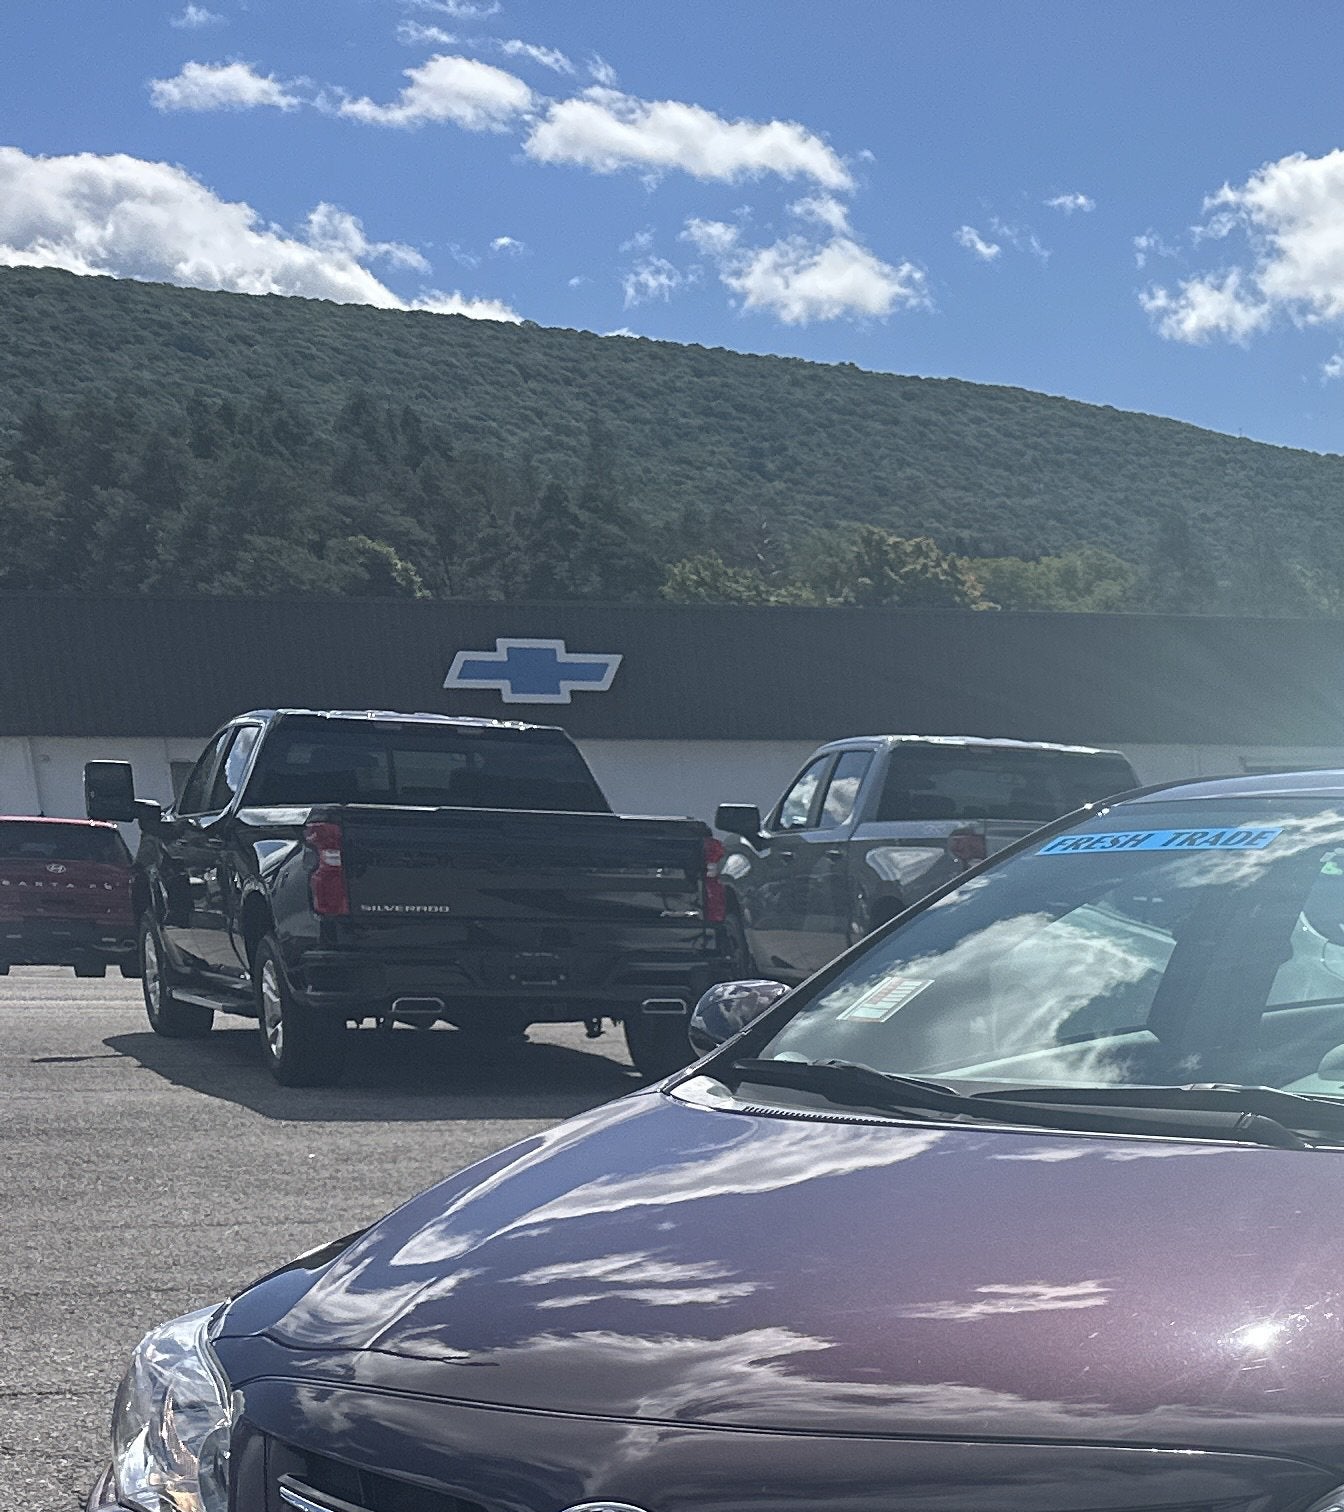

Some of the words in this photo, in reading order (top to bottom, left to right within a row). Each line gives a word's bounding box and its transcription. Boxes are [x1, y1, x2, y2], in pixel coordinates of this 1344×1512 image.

[1049, 833, 1152, 852] FRESH
[1162, 830, 1275, 847] TRADE
[361, 904, 450, 913] SILVERADO
